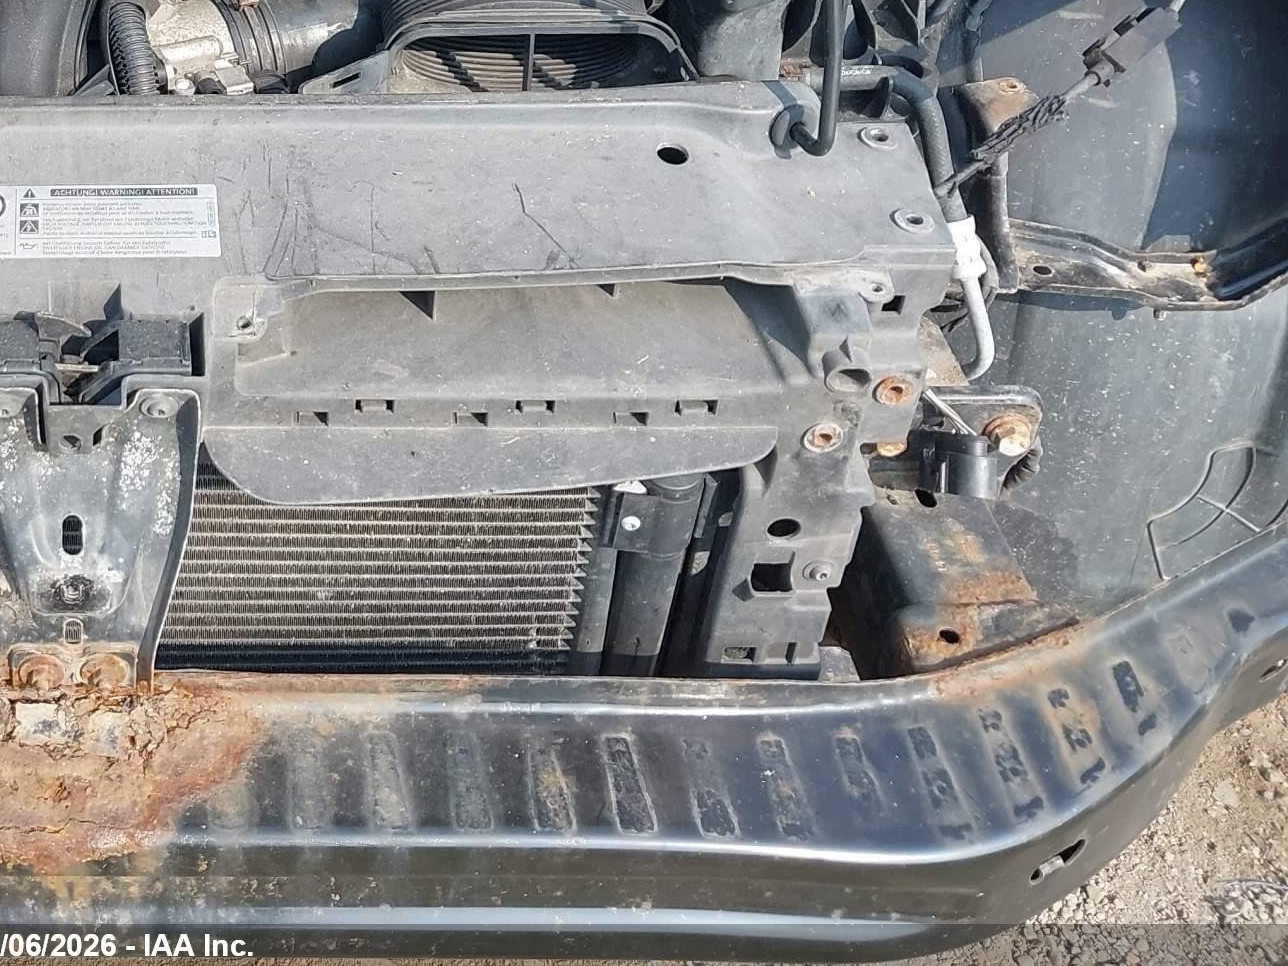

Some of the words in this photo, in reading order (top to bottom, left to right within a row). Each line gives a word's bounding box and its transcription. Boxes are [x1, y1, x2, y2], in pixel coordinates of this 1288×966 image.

[53, 188, 98, 197] ACHTUNG!
[100, 188, 145, 196] WARNING!
[146, 187, 195, 196] ATTENTION!
